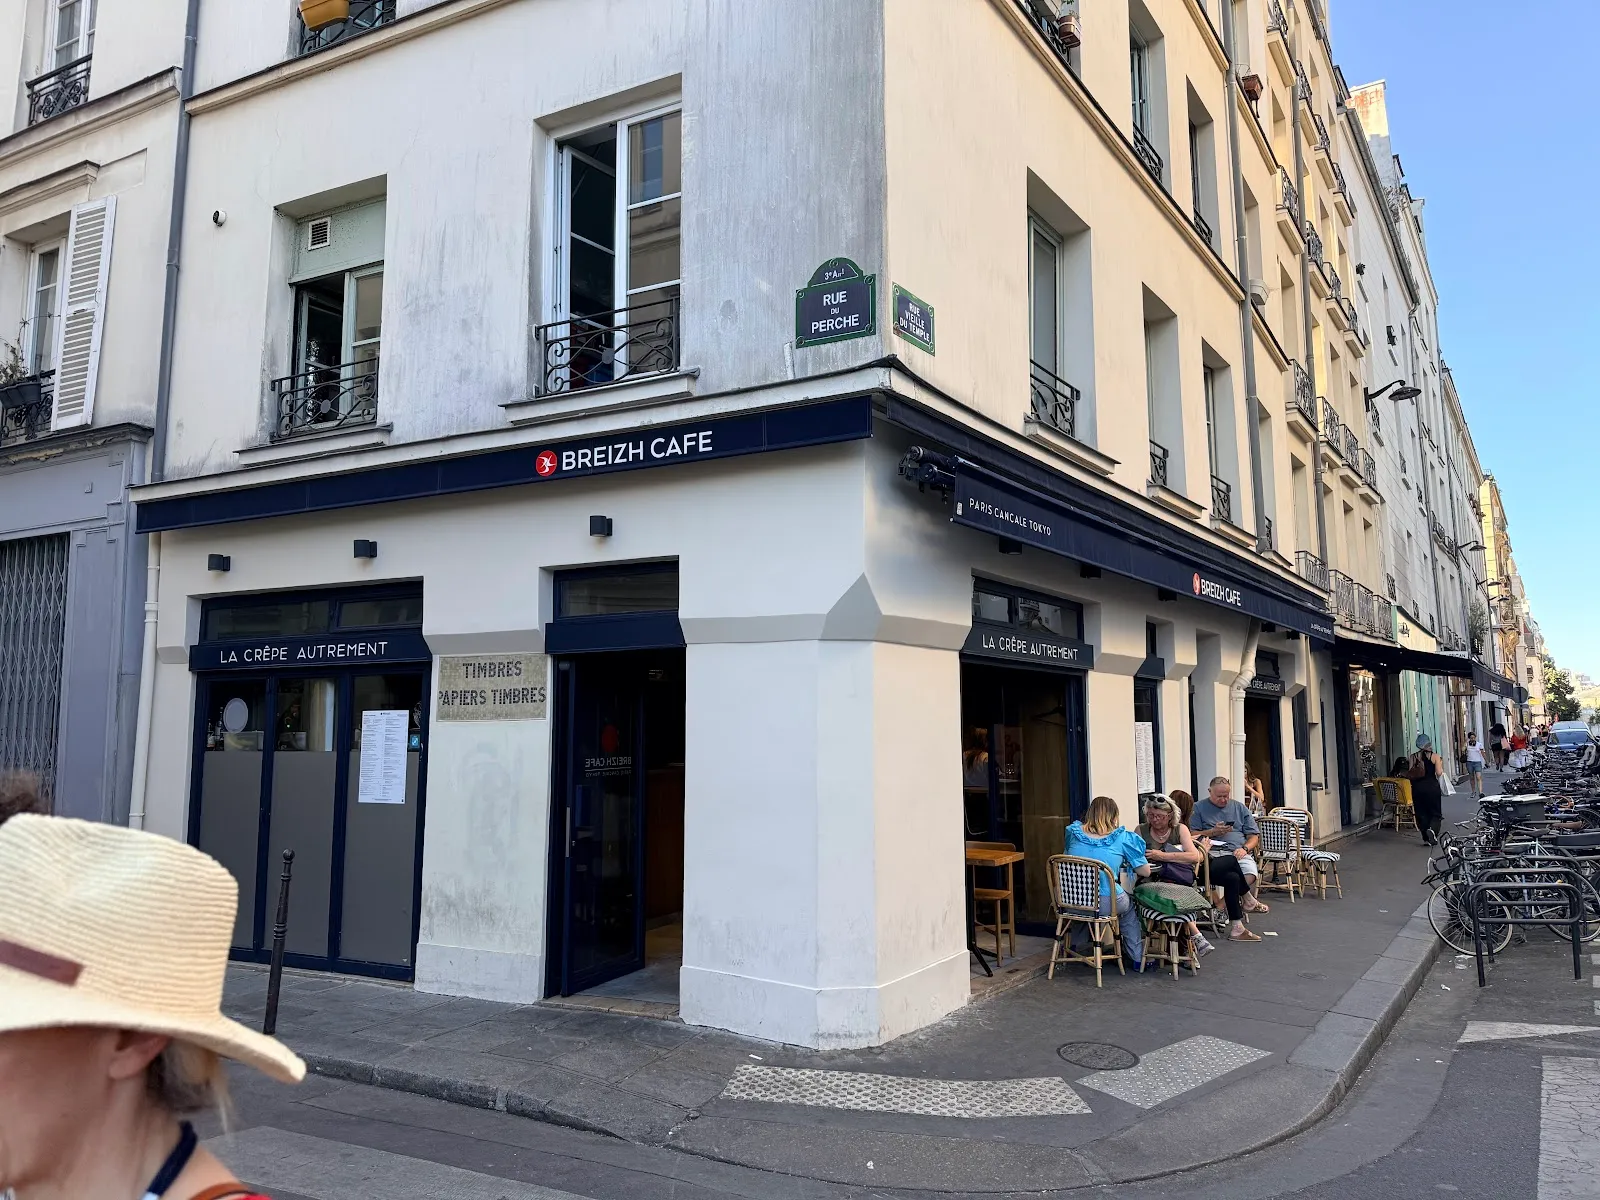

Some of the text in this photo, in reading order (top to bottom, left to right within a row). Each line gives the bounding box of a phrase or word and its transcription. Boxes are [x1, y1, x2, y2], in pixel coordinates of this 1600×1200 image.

[823, 291, 847, 306] RUE
[830, 307, 840, 315] DU
[904, 309, 925, 330] VIEILLE
[909, 302, 921, 317] RUE
[811, 314, 860, 334] PERCHE
[899, 316, 930, 342] DU TEMPLE
[562, 430, 713, 471] BREIZH CAFE
[969, 497, 1052, 536] PARIS CANCALE TOKYO
[1200, 578, 1242, 607] BREIZH CAFE
[220, 641, 389, 664] LA CRÊPE AUTREMENT
[982, 634, 1078, 661] LA CRÊPE AUTREMENT
[462, 660, 522, 679] TIMBRES
[490, 686, 547, 705] TIMBRES
